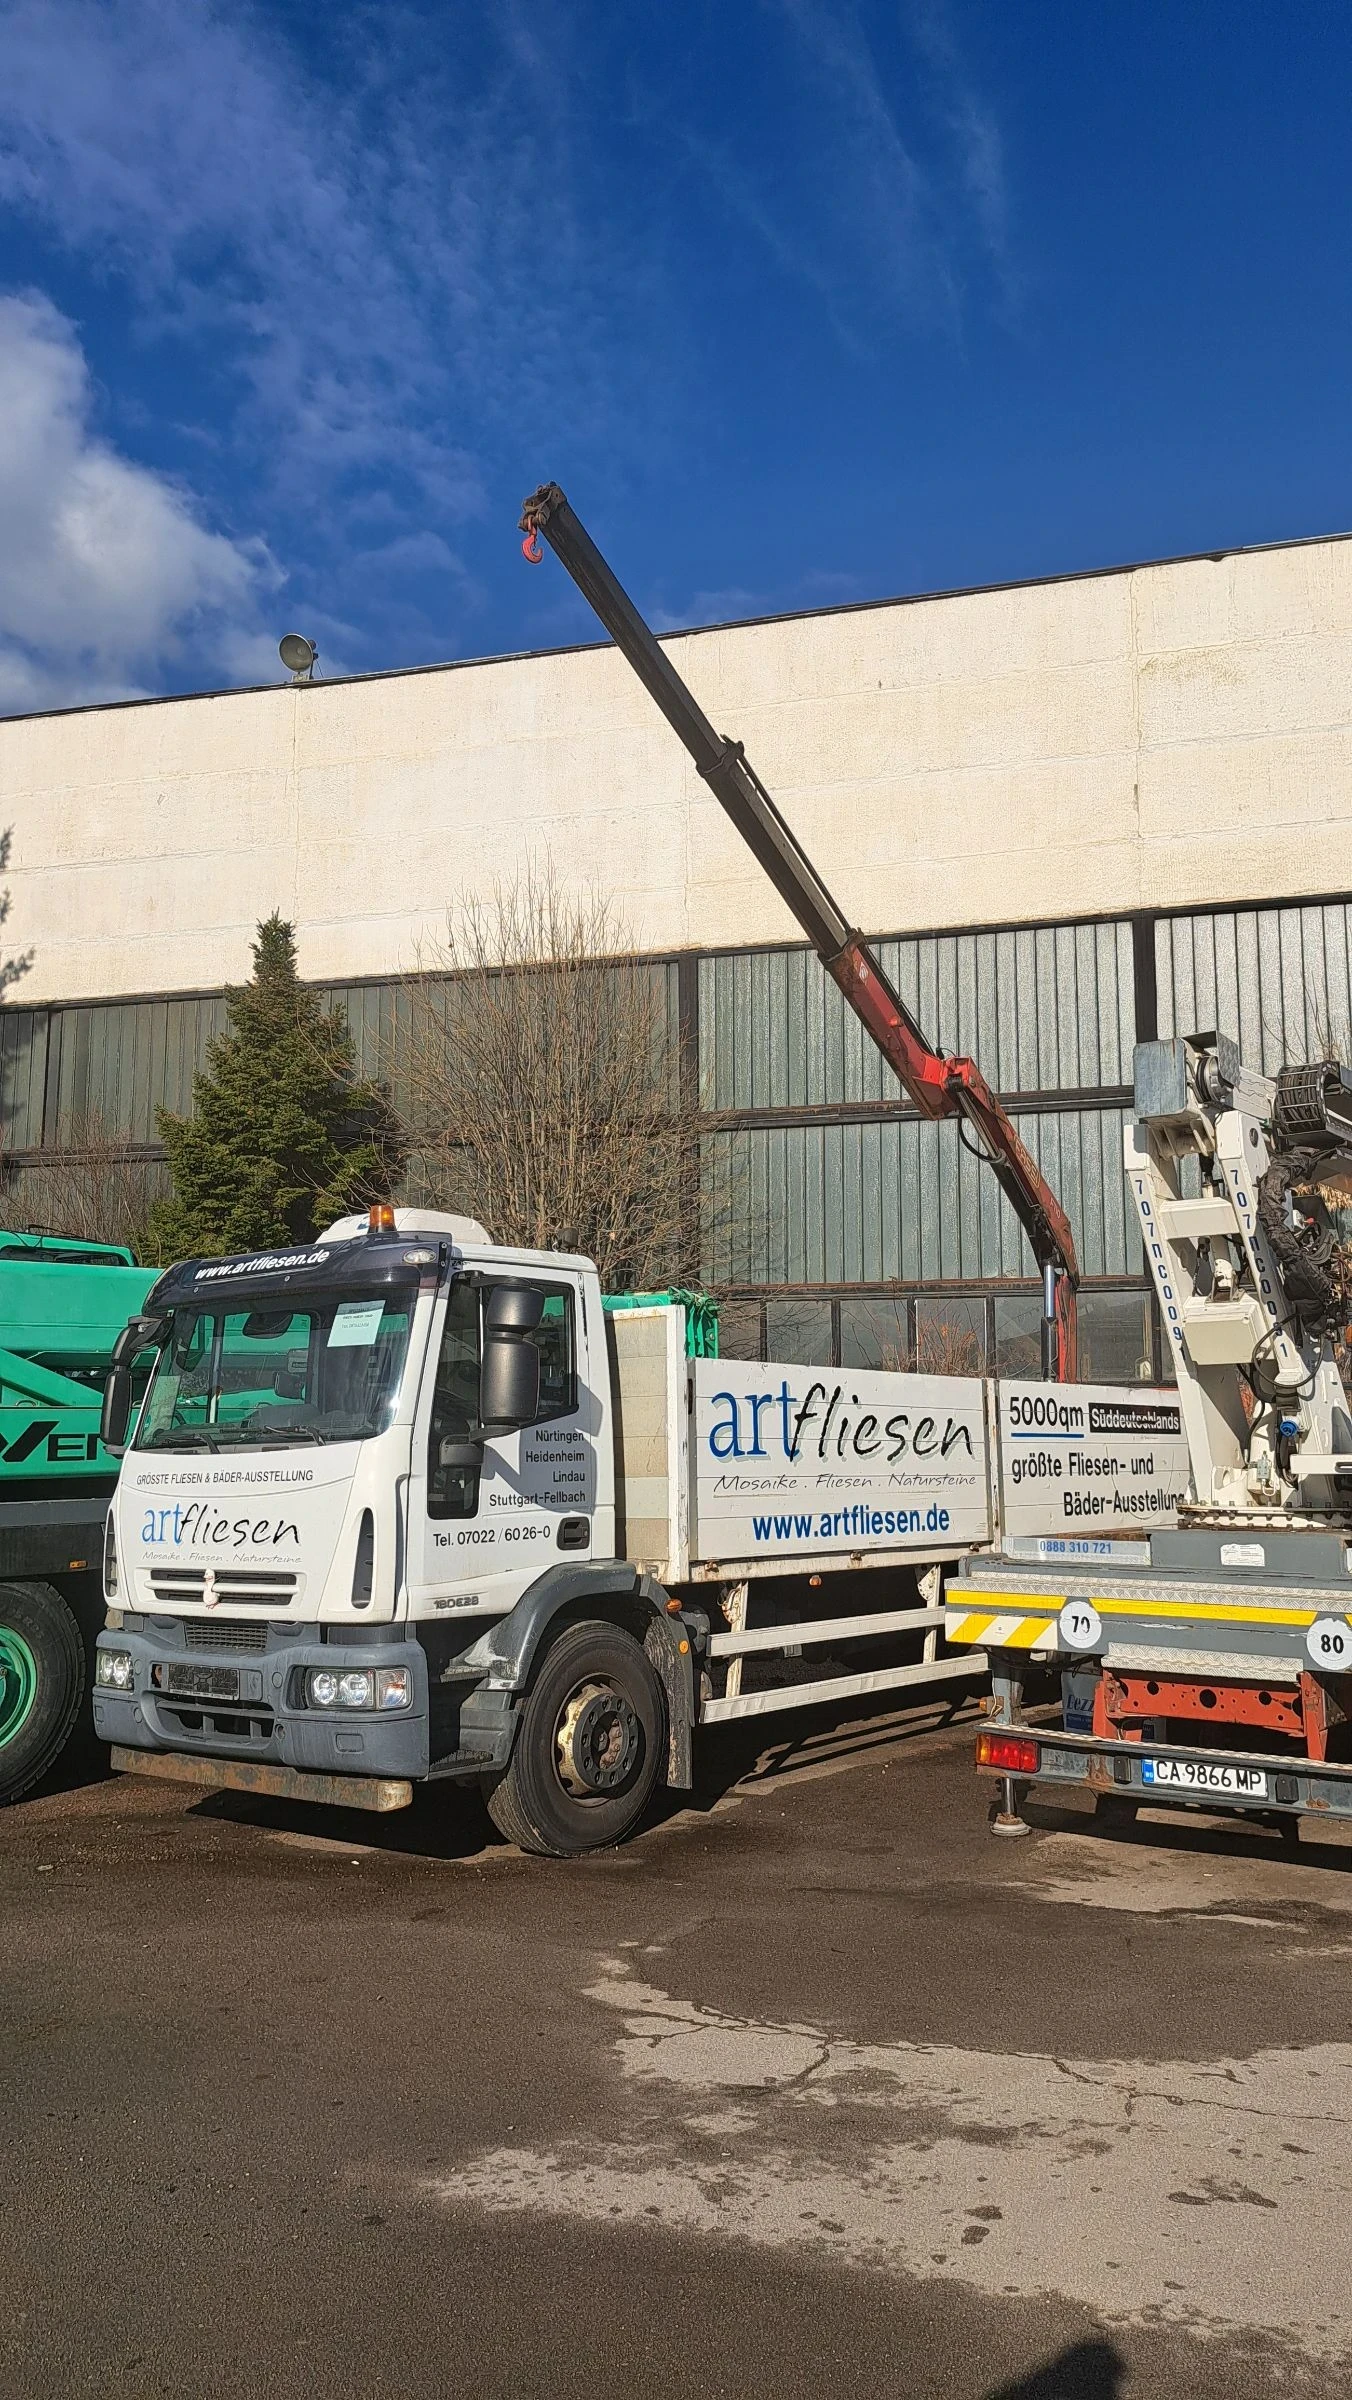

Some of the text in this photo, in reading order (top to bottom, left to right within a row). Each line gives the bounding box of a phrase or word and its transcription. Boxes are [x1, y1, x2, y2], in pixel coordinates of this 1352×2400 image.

[194, 1248, 330, 1280] www.artfliesen.de
[708, 1380, 975, 1464] artfliesen
[1009, 1396, 1085, 1432] 5000qm
[535, 1429, 585, 1444] Nürtingen
[525, 1451, 585, 1464] Heidenheim
[552, 1470, 586, 1483] Lindau
[1011, 1451, 1063, 1484] größte
[1131, 1452, 1155, 1476] und
[136, 1469, 314, 1486] GRÖSSTE FLIESEN & BÄDER-AUSSTELLUNG
[713, 1471, 977, 1493] Mosaike Fliesen Natursteine
[489, 1490, 586, 1508] Stuttgart-Fellbach
[141, 1502, 300, 1547] artfliesen
[752, 1502, 951, 1541] www.artfliesen.de
[433, 1532, 454, 1547] Tel.
[457, 1530, 496, 1546] 07022
[1039, 1540, 1112, 1554] 0888 310 721
[142, 1551, 303, 1563] Mosaike Fliesen Natursteine
[1071, 1615, 1091, 1634] 70
[1320, 1633, 1344, 1655] 80
